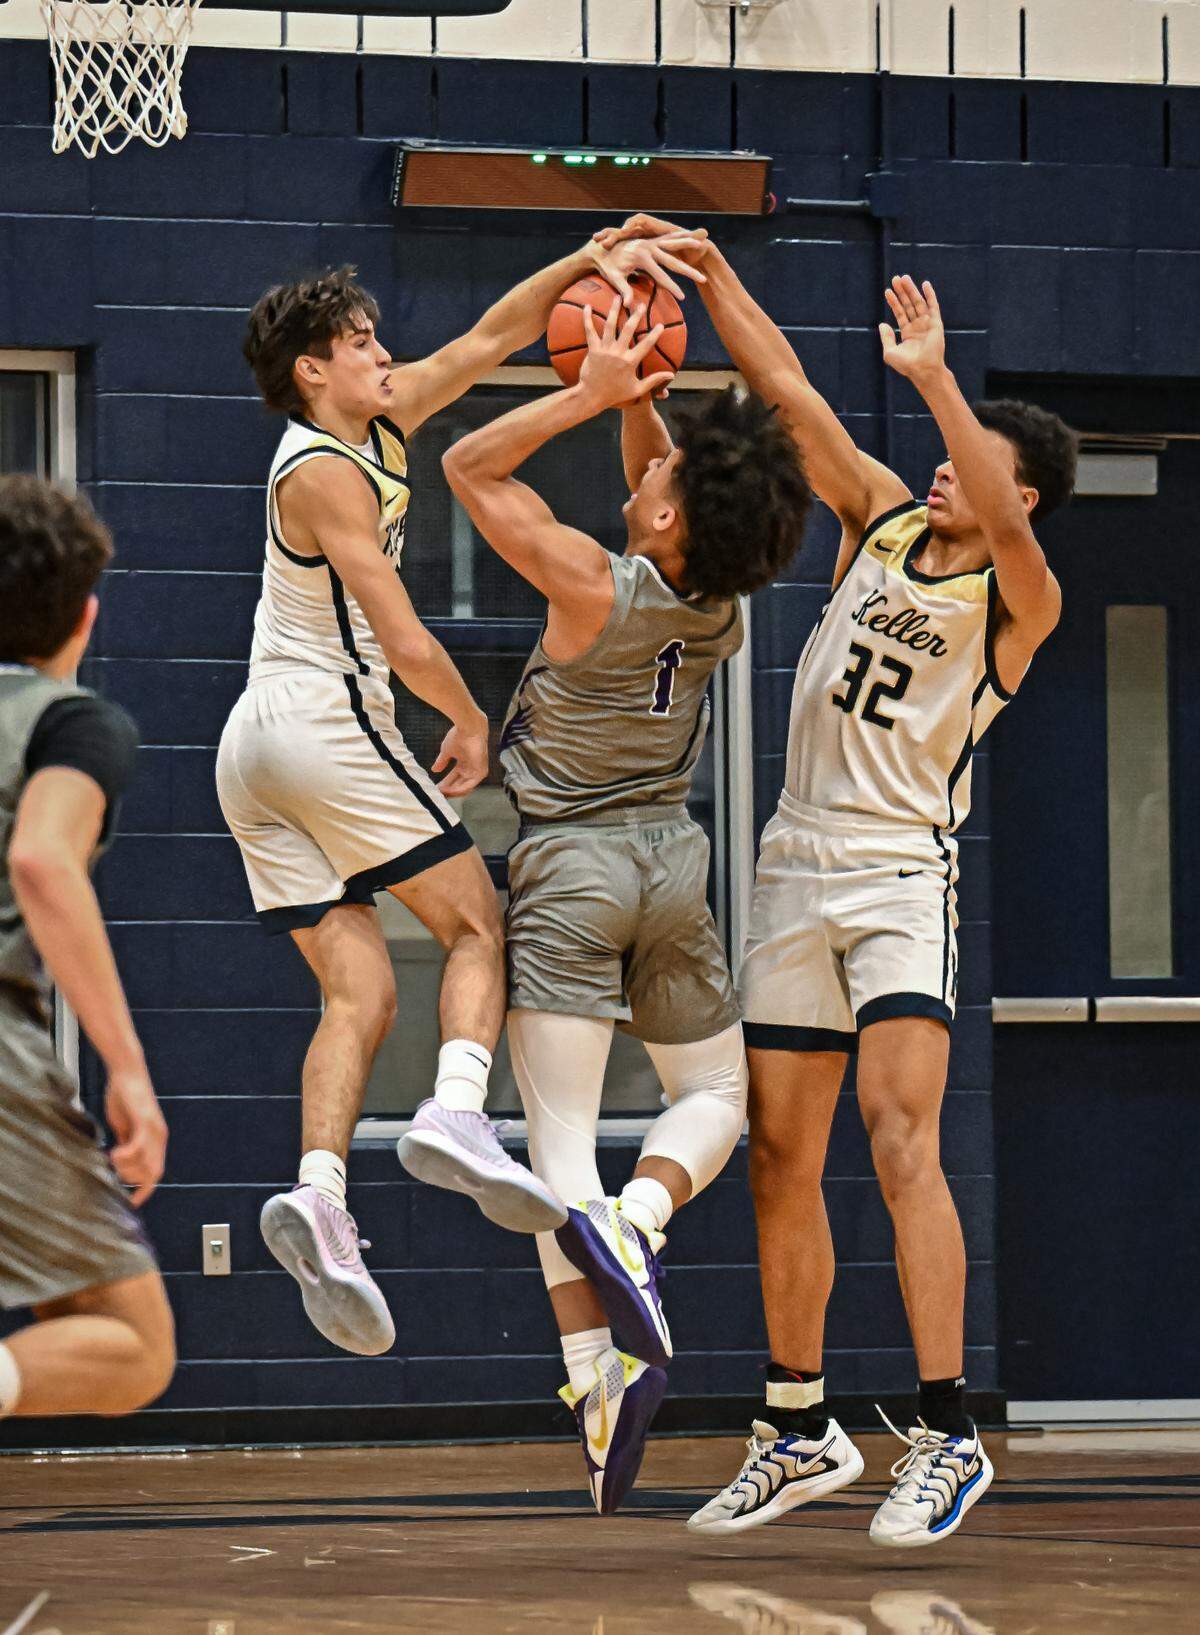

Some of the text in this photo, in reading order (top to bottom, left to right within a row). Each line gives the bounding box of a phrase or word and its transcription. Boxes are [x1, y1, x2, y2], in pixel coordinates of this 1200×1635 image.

[852, 588, 947, 658] Keller
[649, 639, 685, 716] 1
[832, 641, 913, 730] 32
